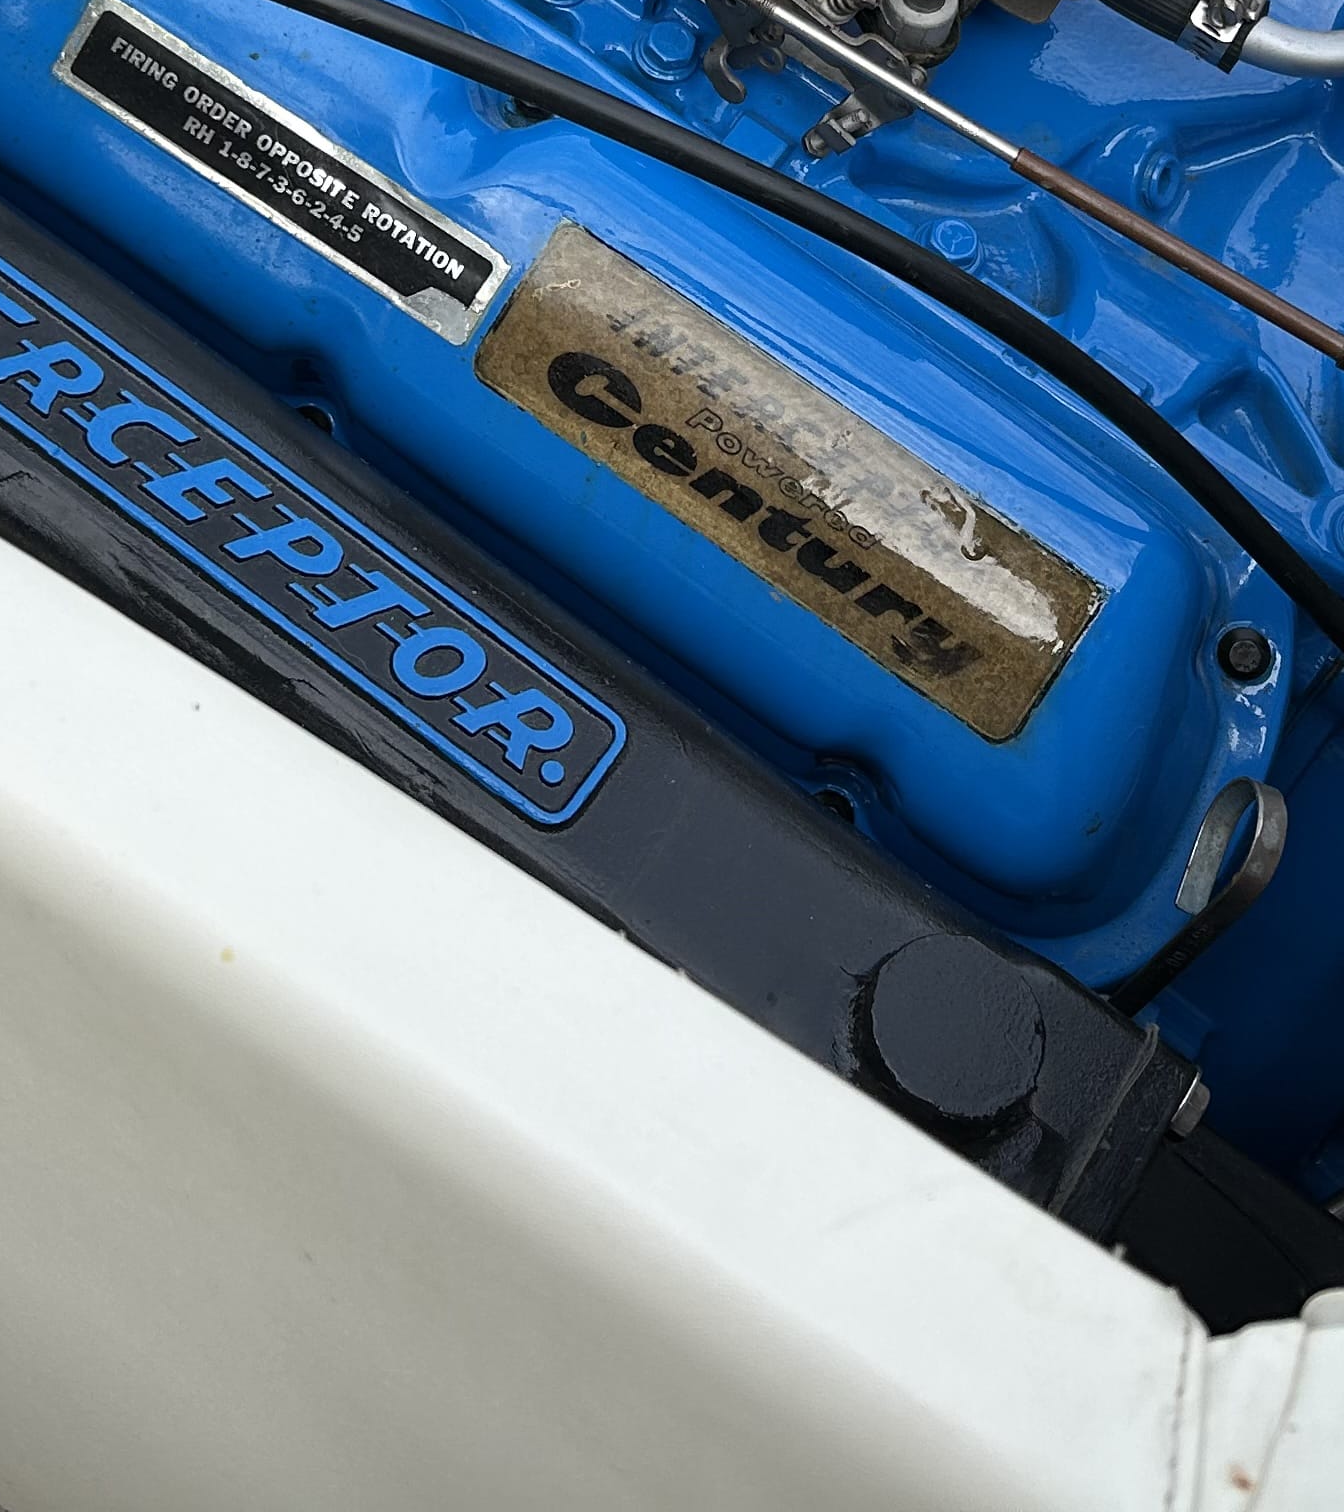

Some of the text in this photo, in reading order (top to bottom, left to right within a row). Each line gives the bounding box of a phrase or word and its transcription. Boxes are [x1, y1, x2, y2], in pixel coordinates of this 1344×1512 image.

[110, 36, 466, 281] FIRING ORDER OPPOSITE ROTATION
[182, 115, 363, 244] RH 1-8-7-3-6-2-4-5
[547, 351, 983, 676] Century
[684, 403, 888, 552] Powered
